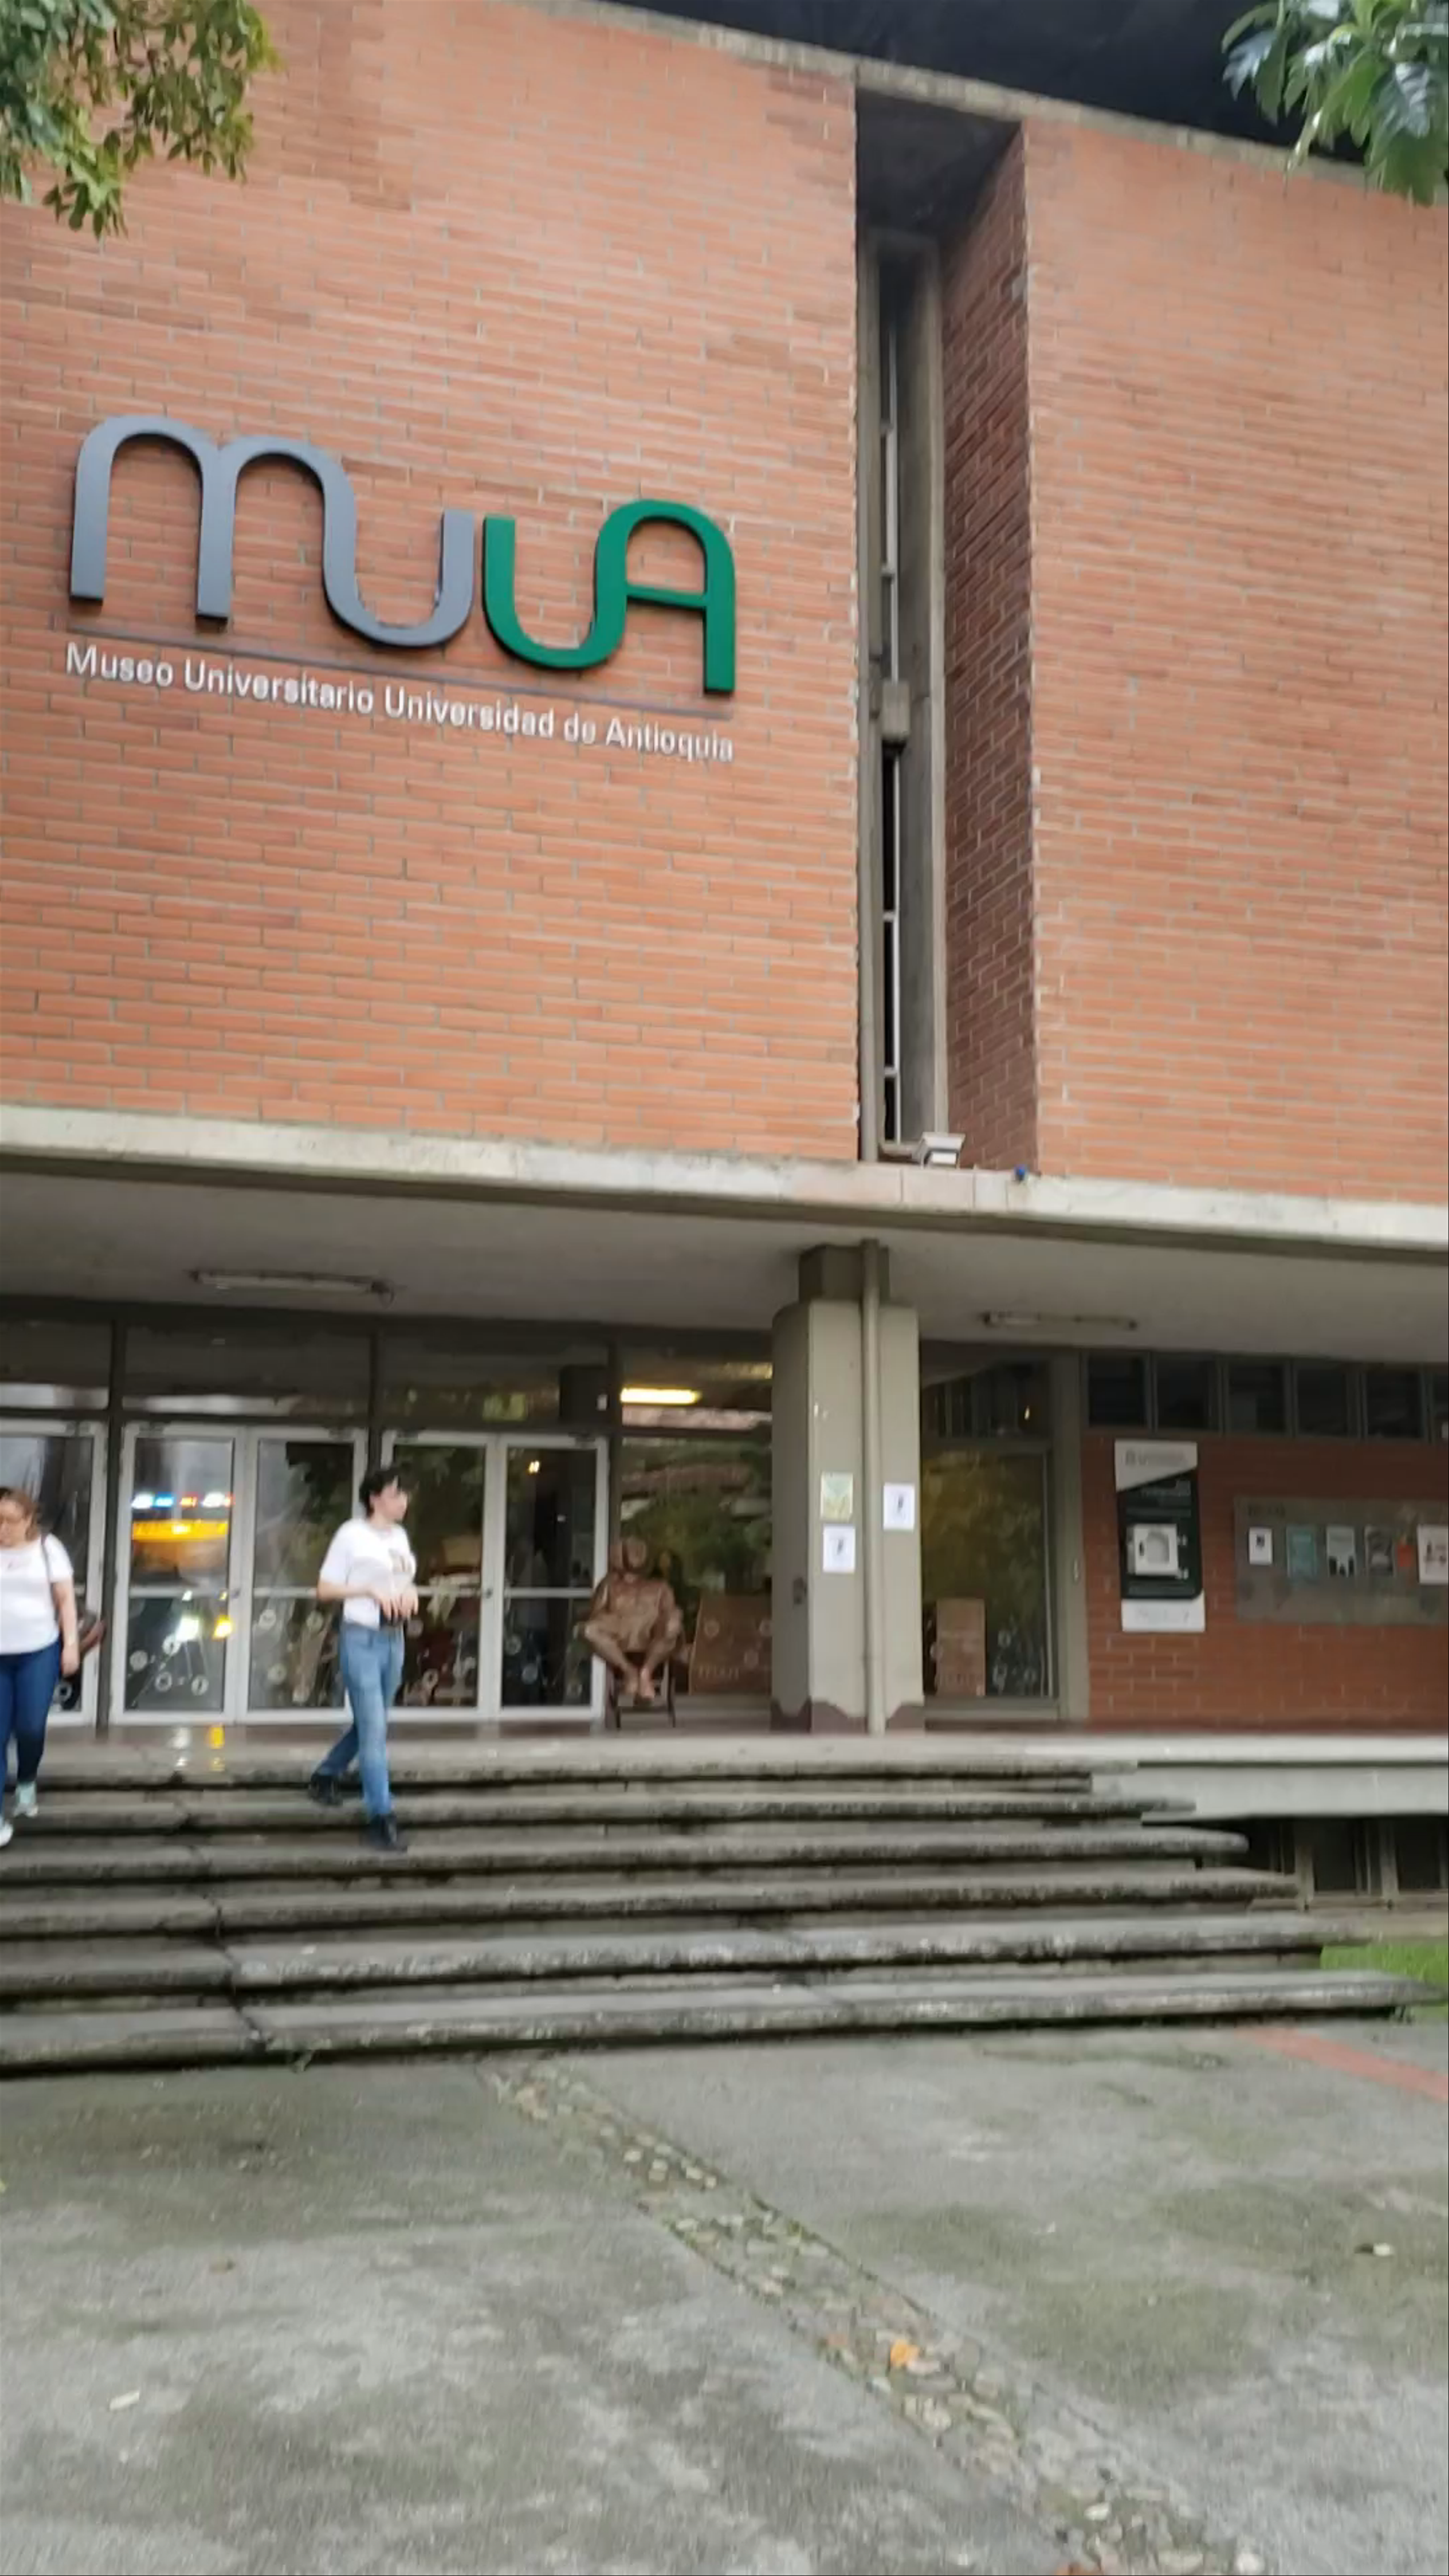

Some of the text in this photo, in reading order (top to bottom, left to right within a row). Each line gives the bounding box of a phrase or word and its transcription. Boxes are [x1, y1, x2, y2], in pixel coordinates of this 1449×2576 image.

[66, 641, 733, 762] Museo Universitario Universidad de Antioquia
